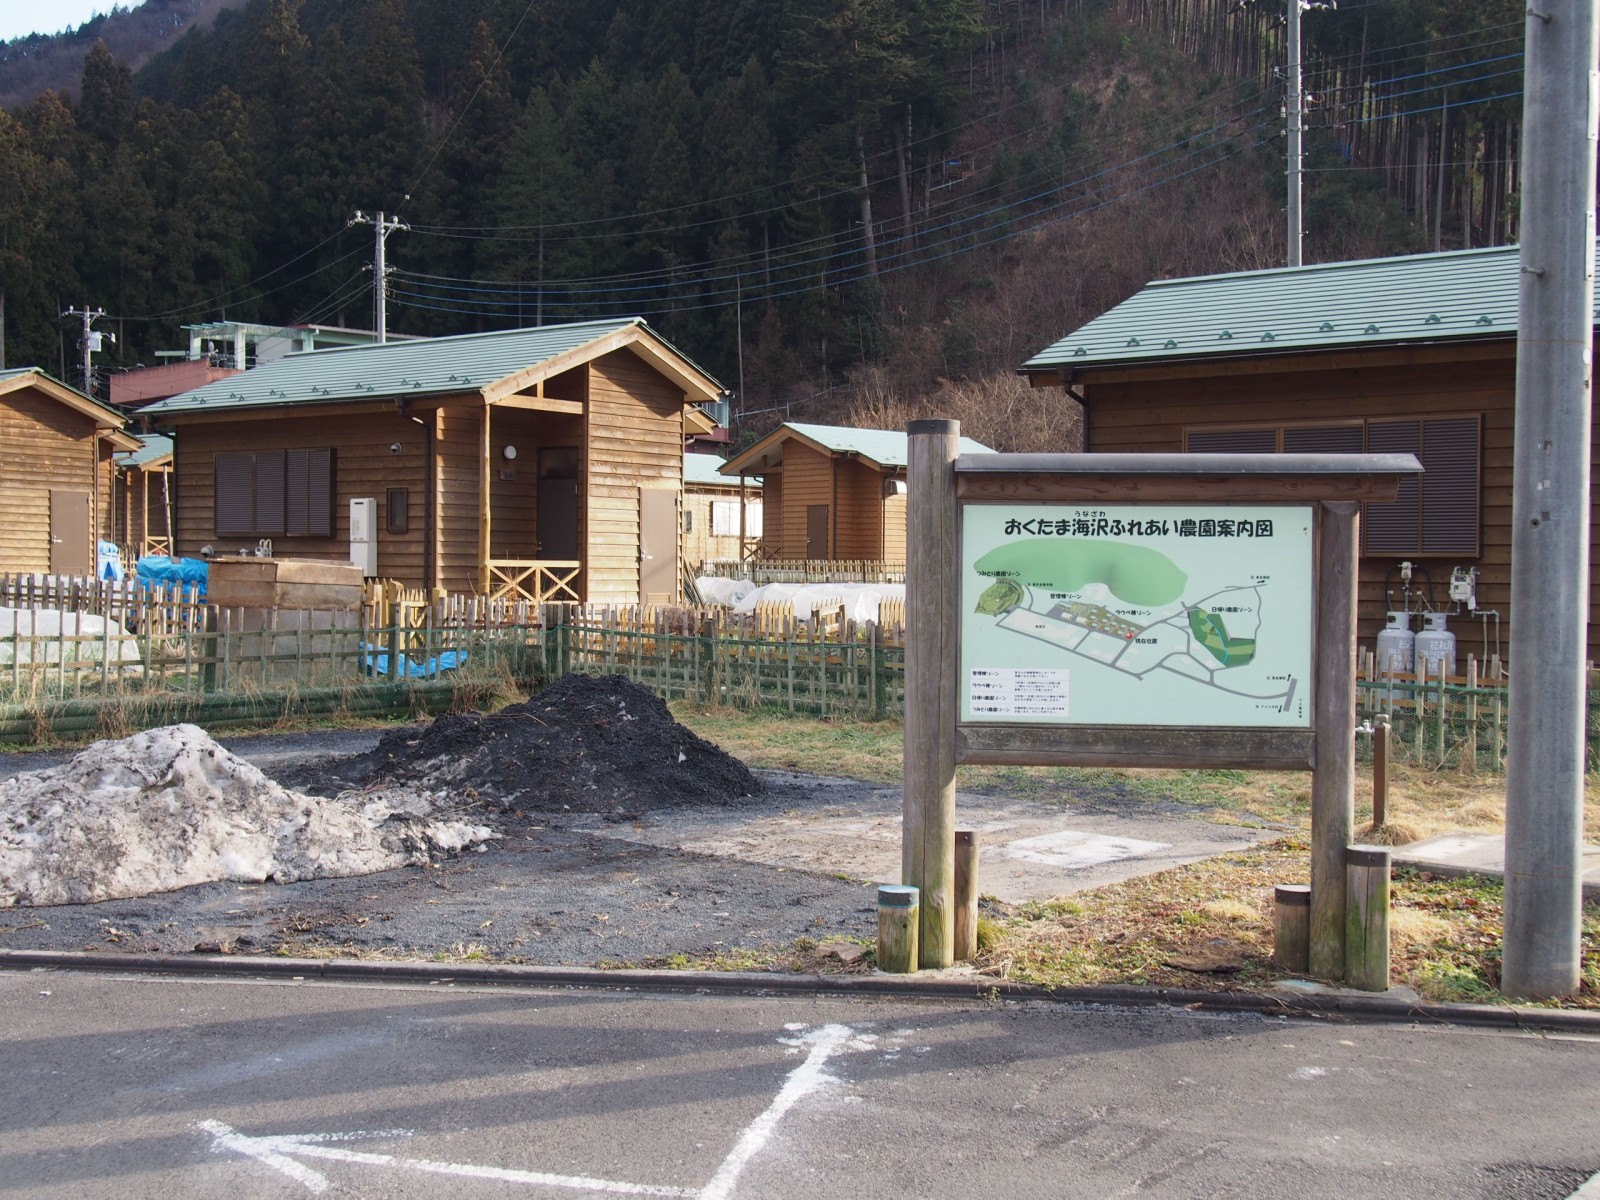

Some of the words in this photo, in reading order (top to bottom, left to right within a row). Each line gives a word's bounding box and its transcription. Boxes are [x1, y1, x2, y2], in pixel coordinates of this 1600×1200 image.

[1004, 518, 1274, 538] おくたま海沢ふれあい農園案内図
